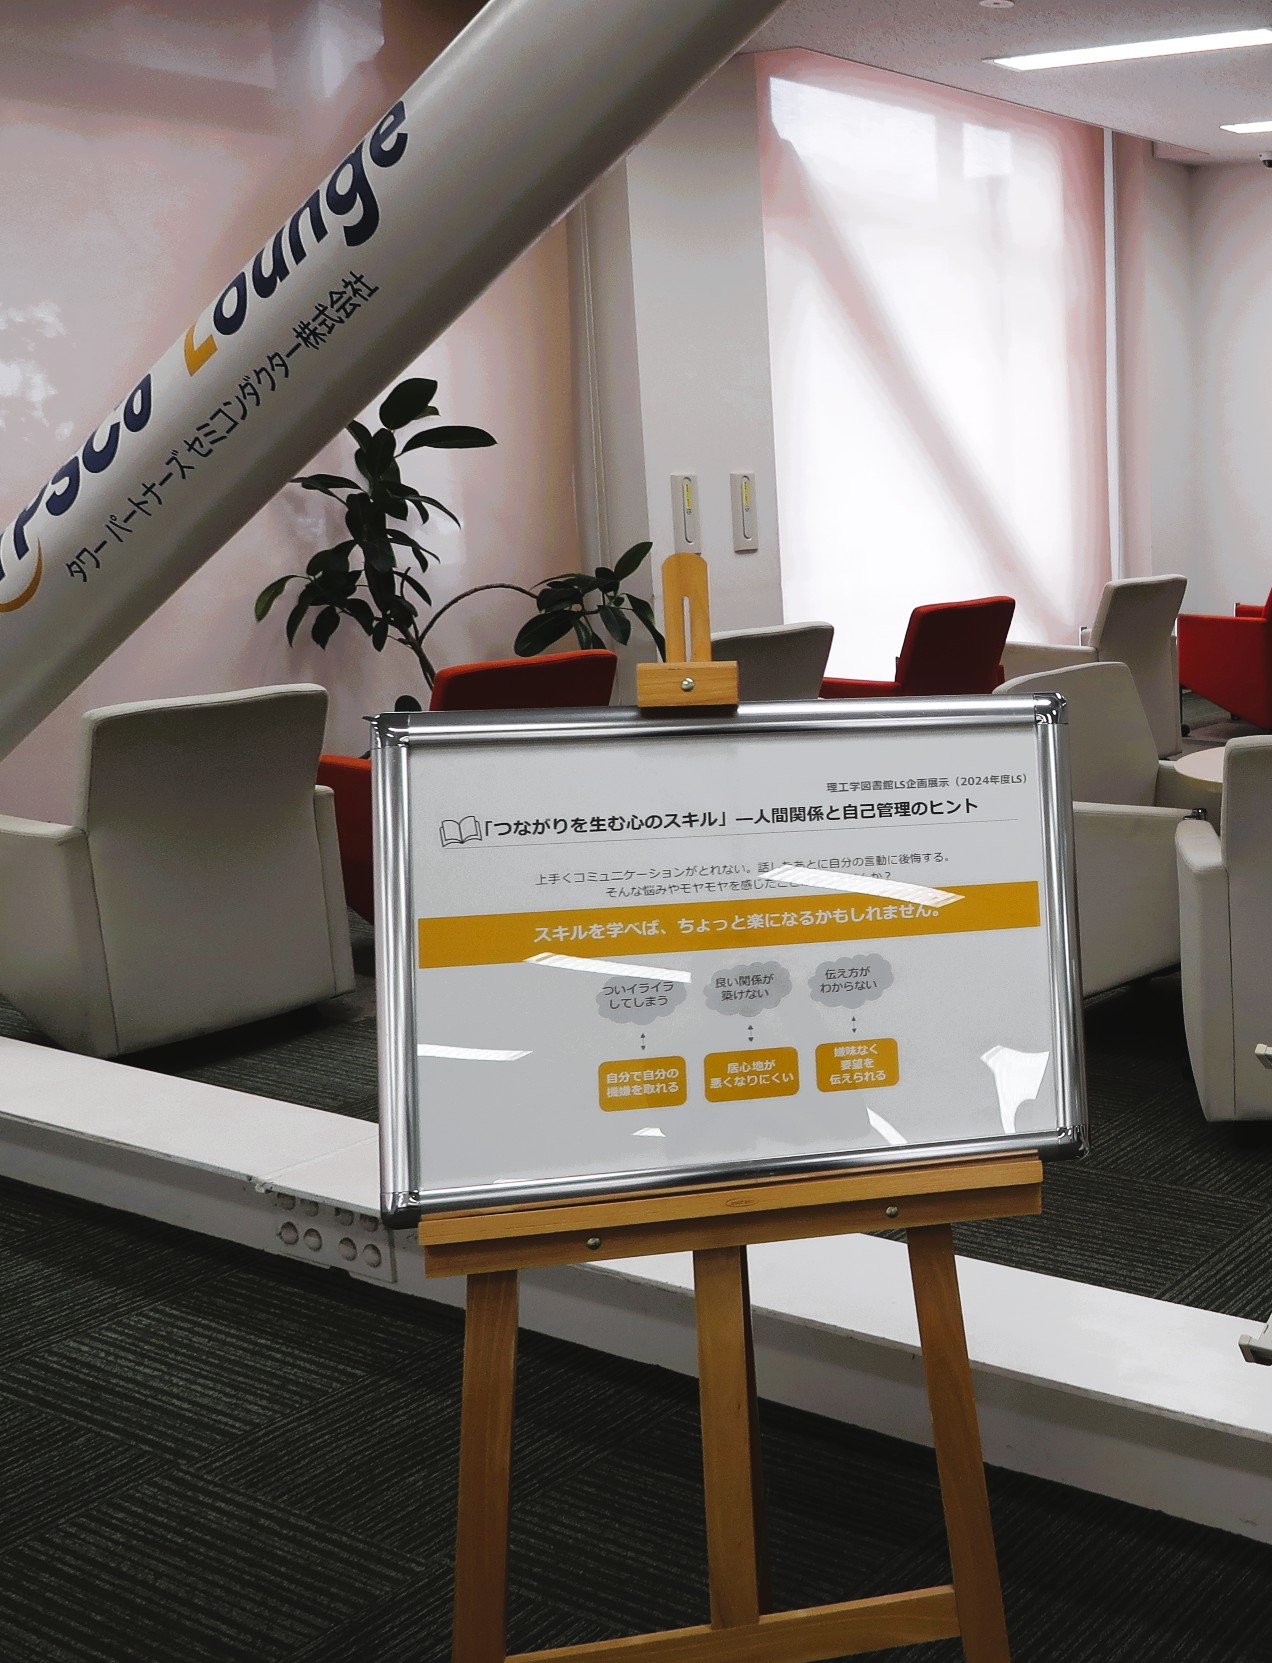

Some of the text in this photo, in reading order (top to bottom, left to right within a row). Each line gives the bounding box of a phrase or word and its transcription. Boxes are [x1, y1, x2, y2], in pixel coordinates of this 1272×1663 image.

[184, 100, 409, 377] Lounge
[66, 271, 380, 582] タワー パートナーズ セミコンダクター株式会社
[534, 903, 939, 943] スキルを学べば、ちょっと楽になるかもしれません。
[824, 965, 871, 980] 伝え方が
[602, 980, 674, 996] ついイライラ
[715, 973, 774, 989] 良い関係が
[820, 979, 877, 993] わからない
[609, 995, 668, 1010] してしまう
[721, 987, 769, 1002] 築けない
[833, 1043, 878, 1058] 嫌味なく
[727, 1059, 775, 1074] 居心地が
[606, 1067, 679, 1084] 自分で自分の
[709, 1071, 794, 1090] 悪くなりにくい
[829, 1070, 887, 1086] 伝えられる
